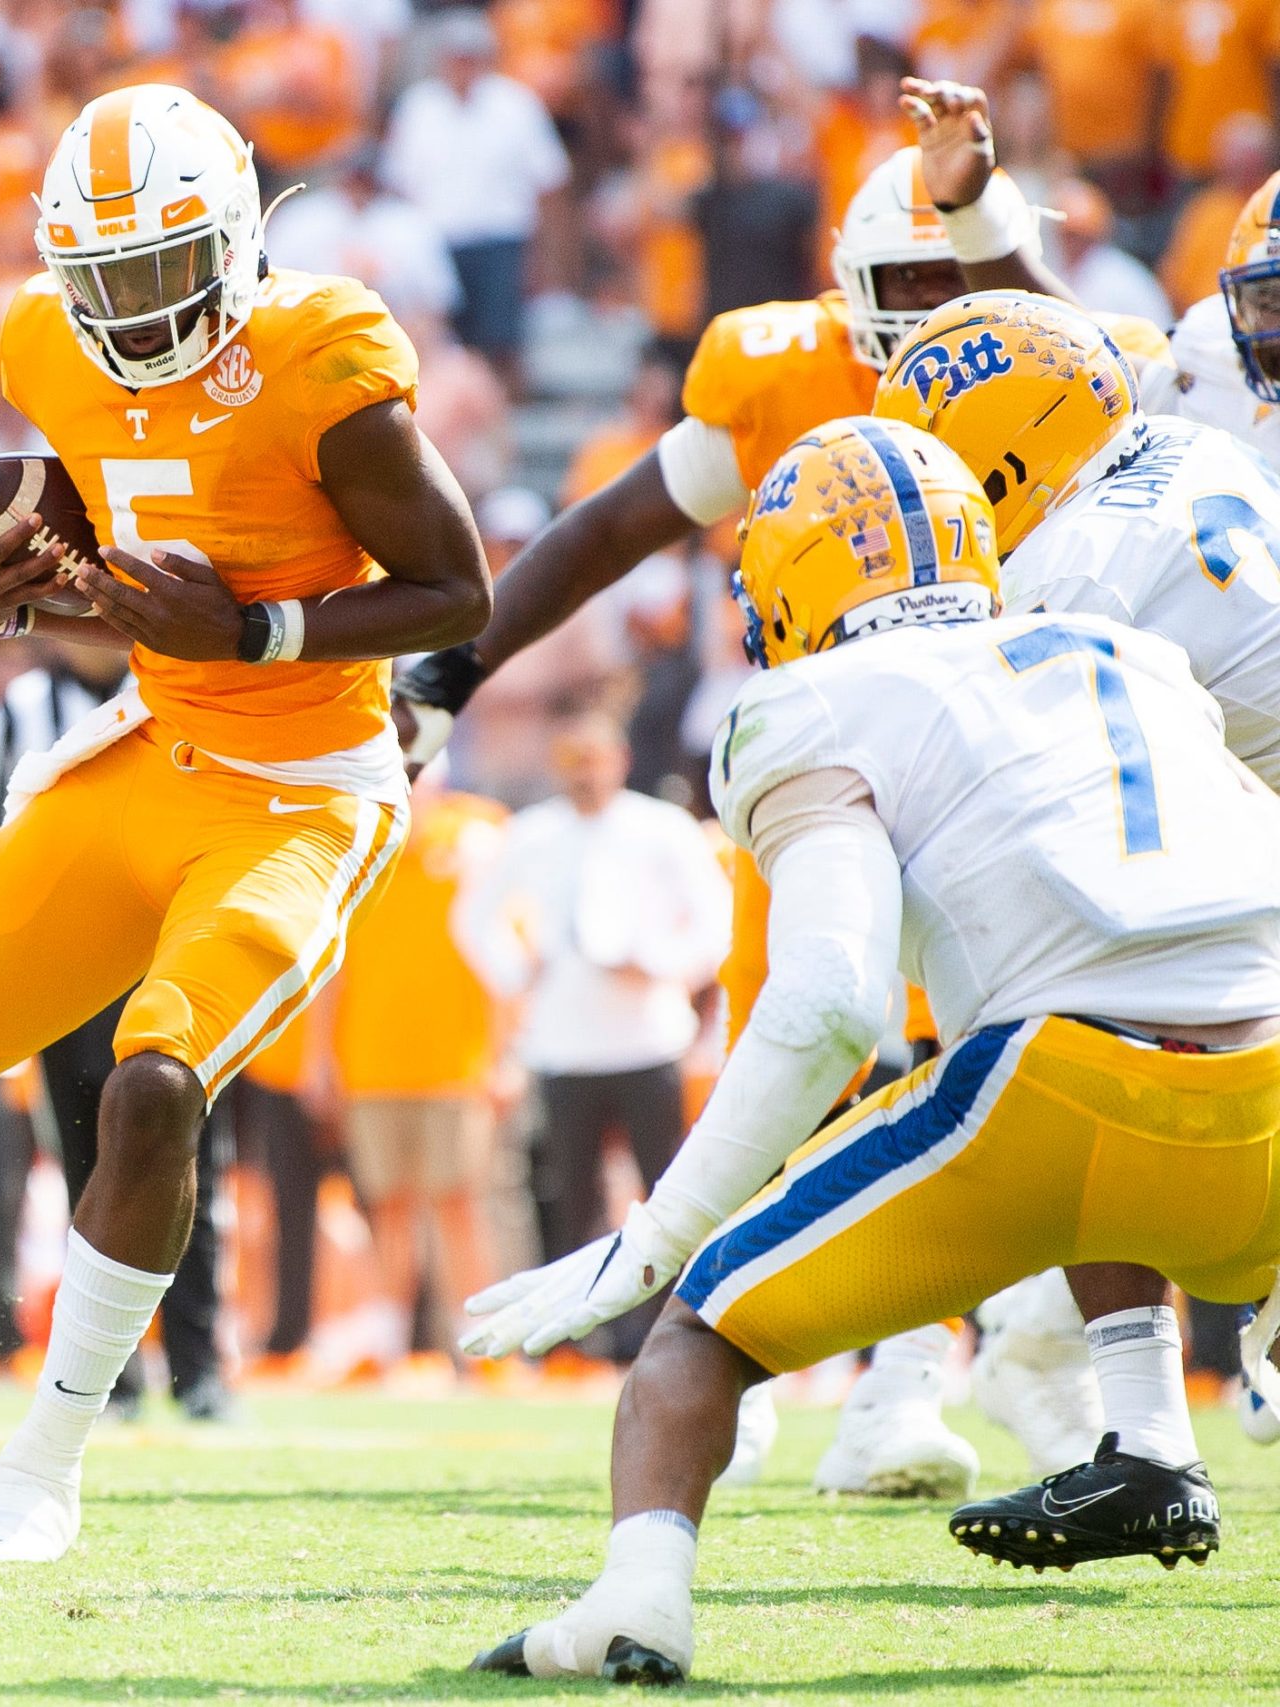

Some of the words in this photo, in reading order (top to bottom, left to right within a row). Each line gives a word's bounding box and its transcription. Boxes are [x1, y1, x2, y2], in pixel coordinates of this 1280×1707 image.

[96, 218, 138, 237] VOLS
[144, 352, 177, 370] Ridde
[215, 344, 252, 389] SEC
[901, 332, 1013, 404] Pitt
[210, 383, 258, 405] GRADUATE
[126, 409, 150, 440] T
[100, 458, 214, 582] 5
[945, 518, 964, 560] 7
[895, 594, 959, 612] Panthers
[989, 622, 1167, 864] 7
